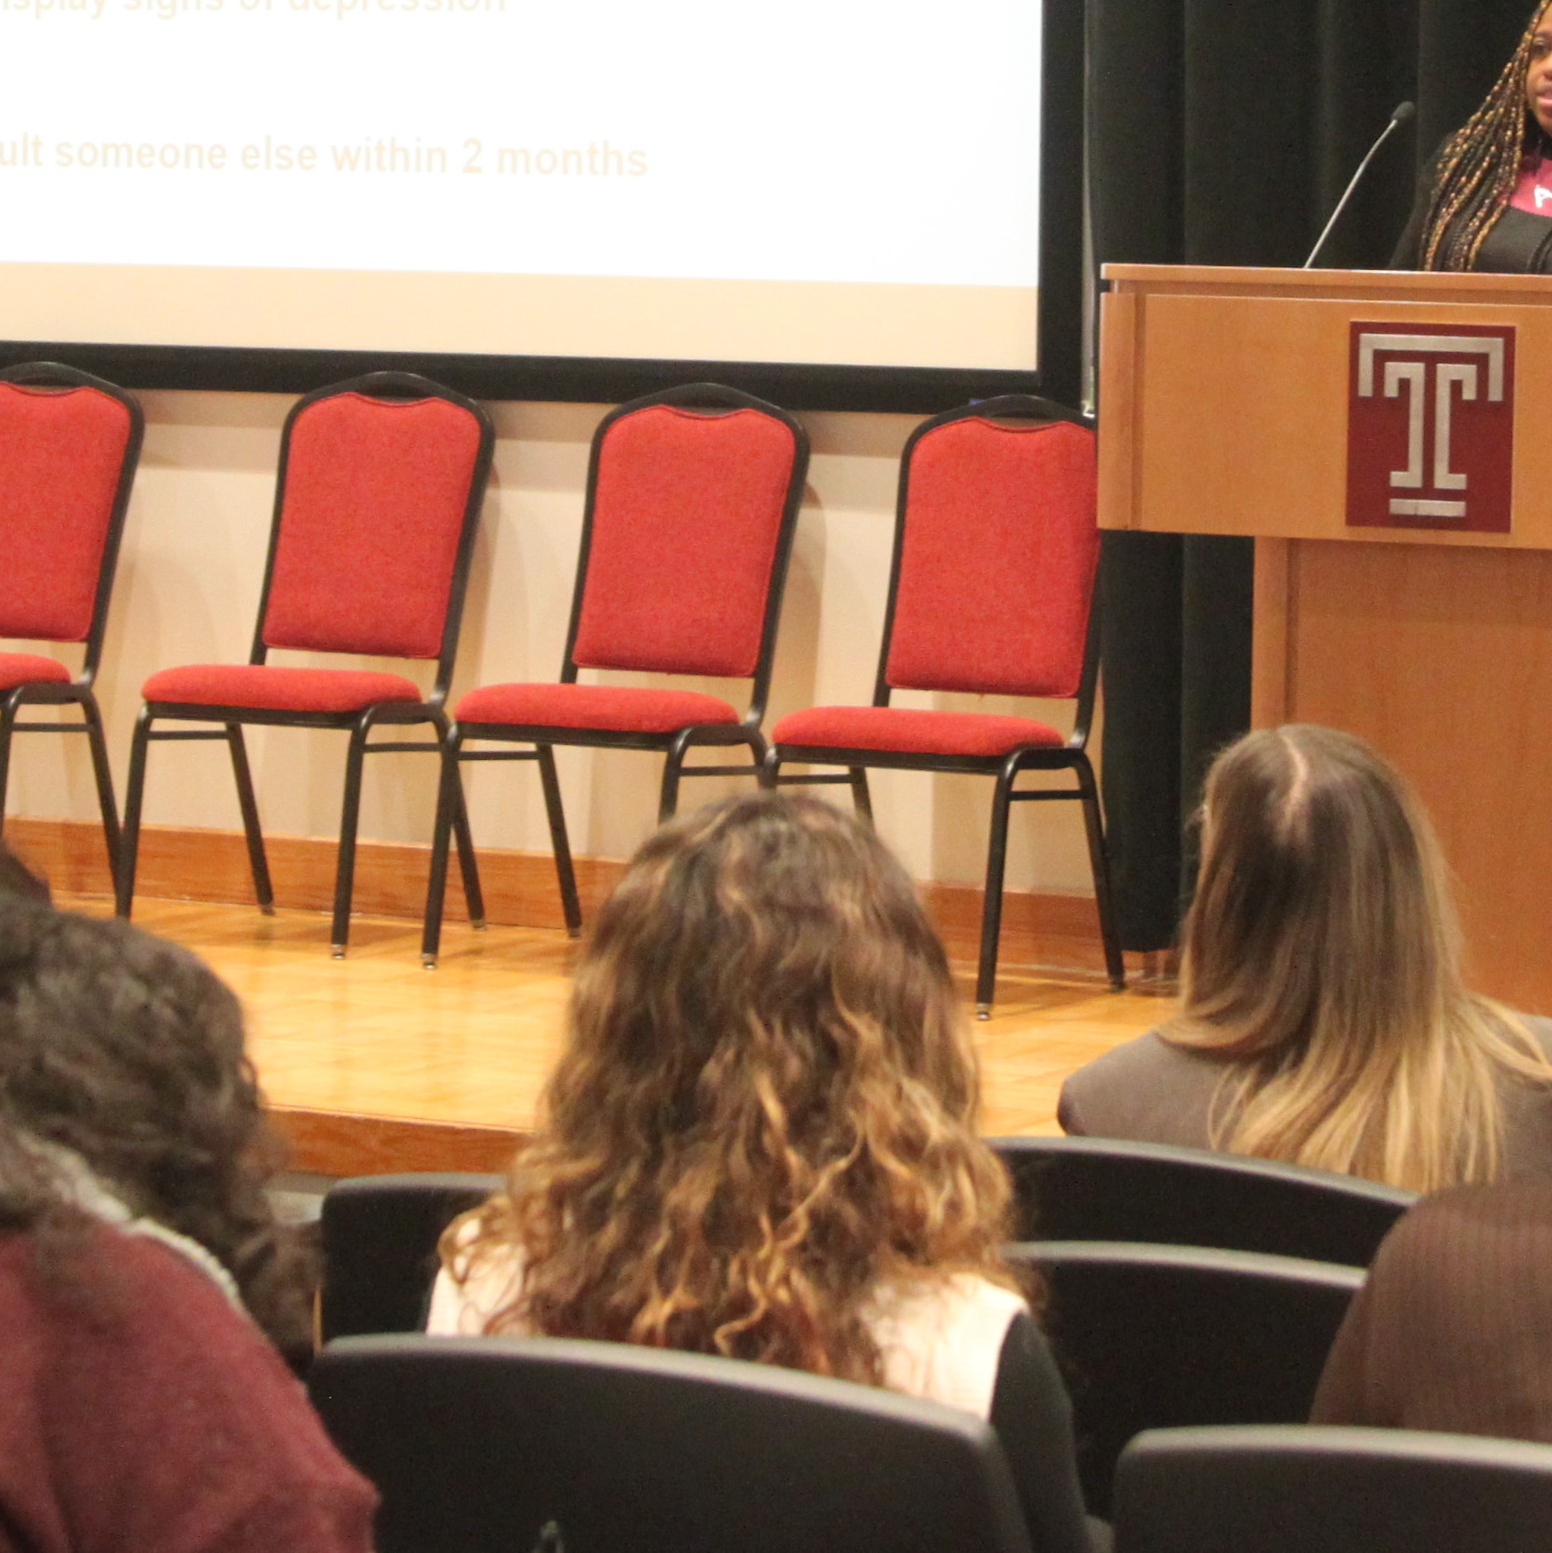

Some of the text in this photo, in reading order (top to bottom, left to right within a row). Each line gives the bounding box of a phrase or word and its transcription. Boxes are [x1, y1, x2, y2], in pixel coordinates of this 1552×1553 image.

[55, 143, 227, 171] someone
[241, 137, 318, 171] else
[331, 137, 448, 173] within
[461, 141, 483, 174] 2
[496, 140, 649, 177] months
